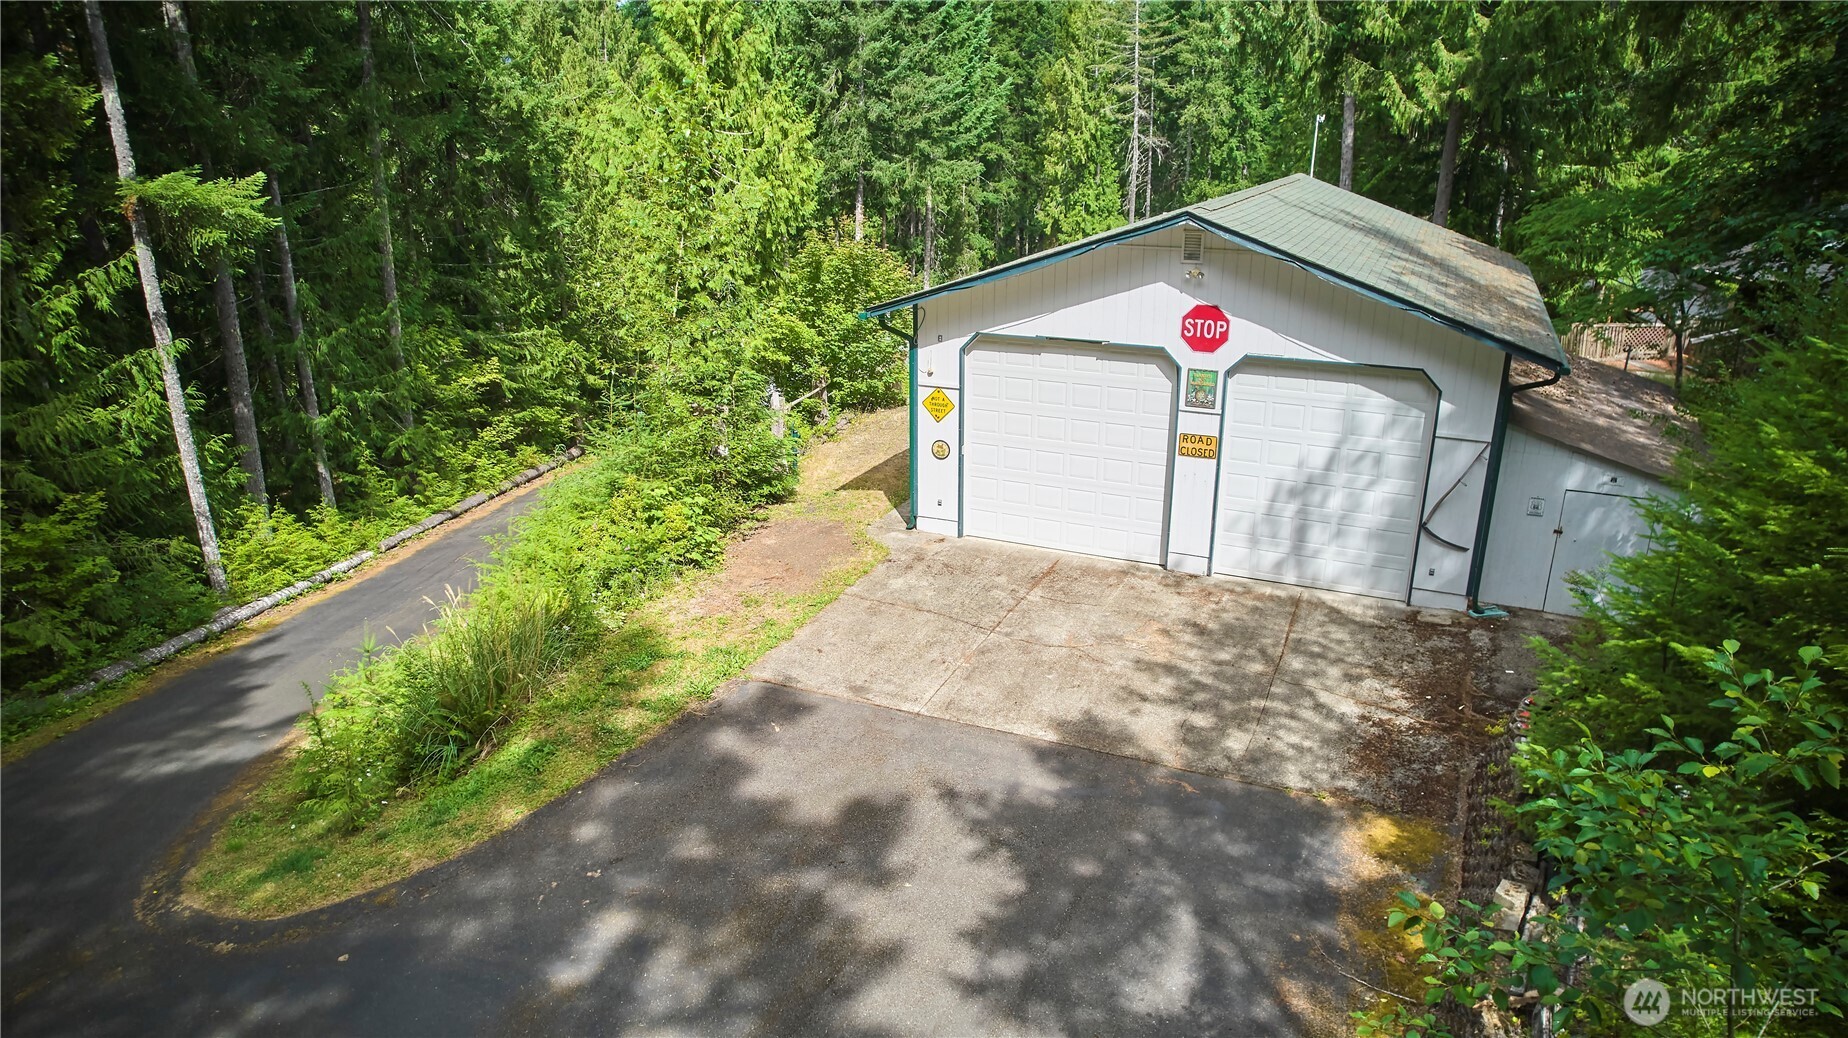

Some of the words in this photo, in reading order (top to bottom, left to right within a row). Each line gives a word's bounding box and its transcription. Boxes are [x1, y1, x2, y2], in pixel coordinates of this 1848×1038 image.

[1184, 319, 1228, 339] STOP
[1182, 434, 1213, 446] ROAD
[1180, 446, 1215, 458] CLOSED
